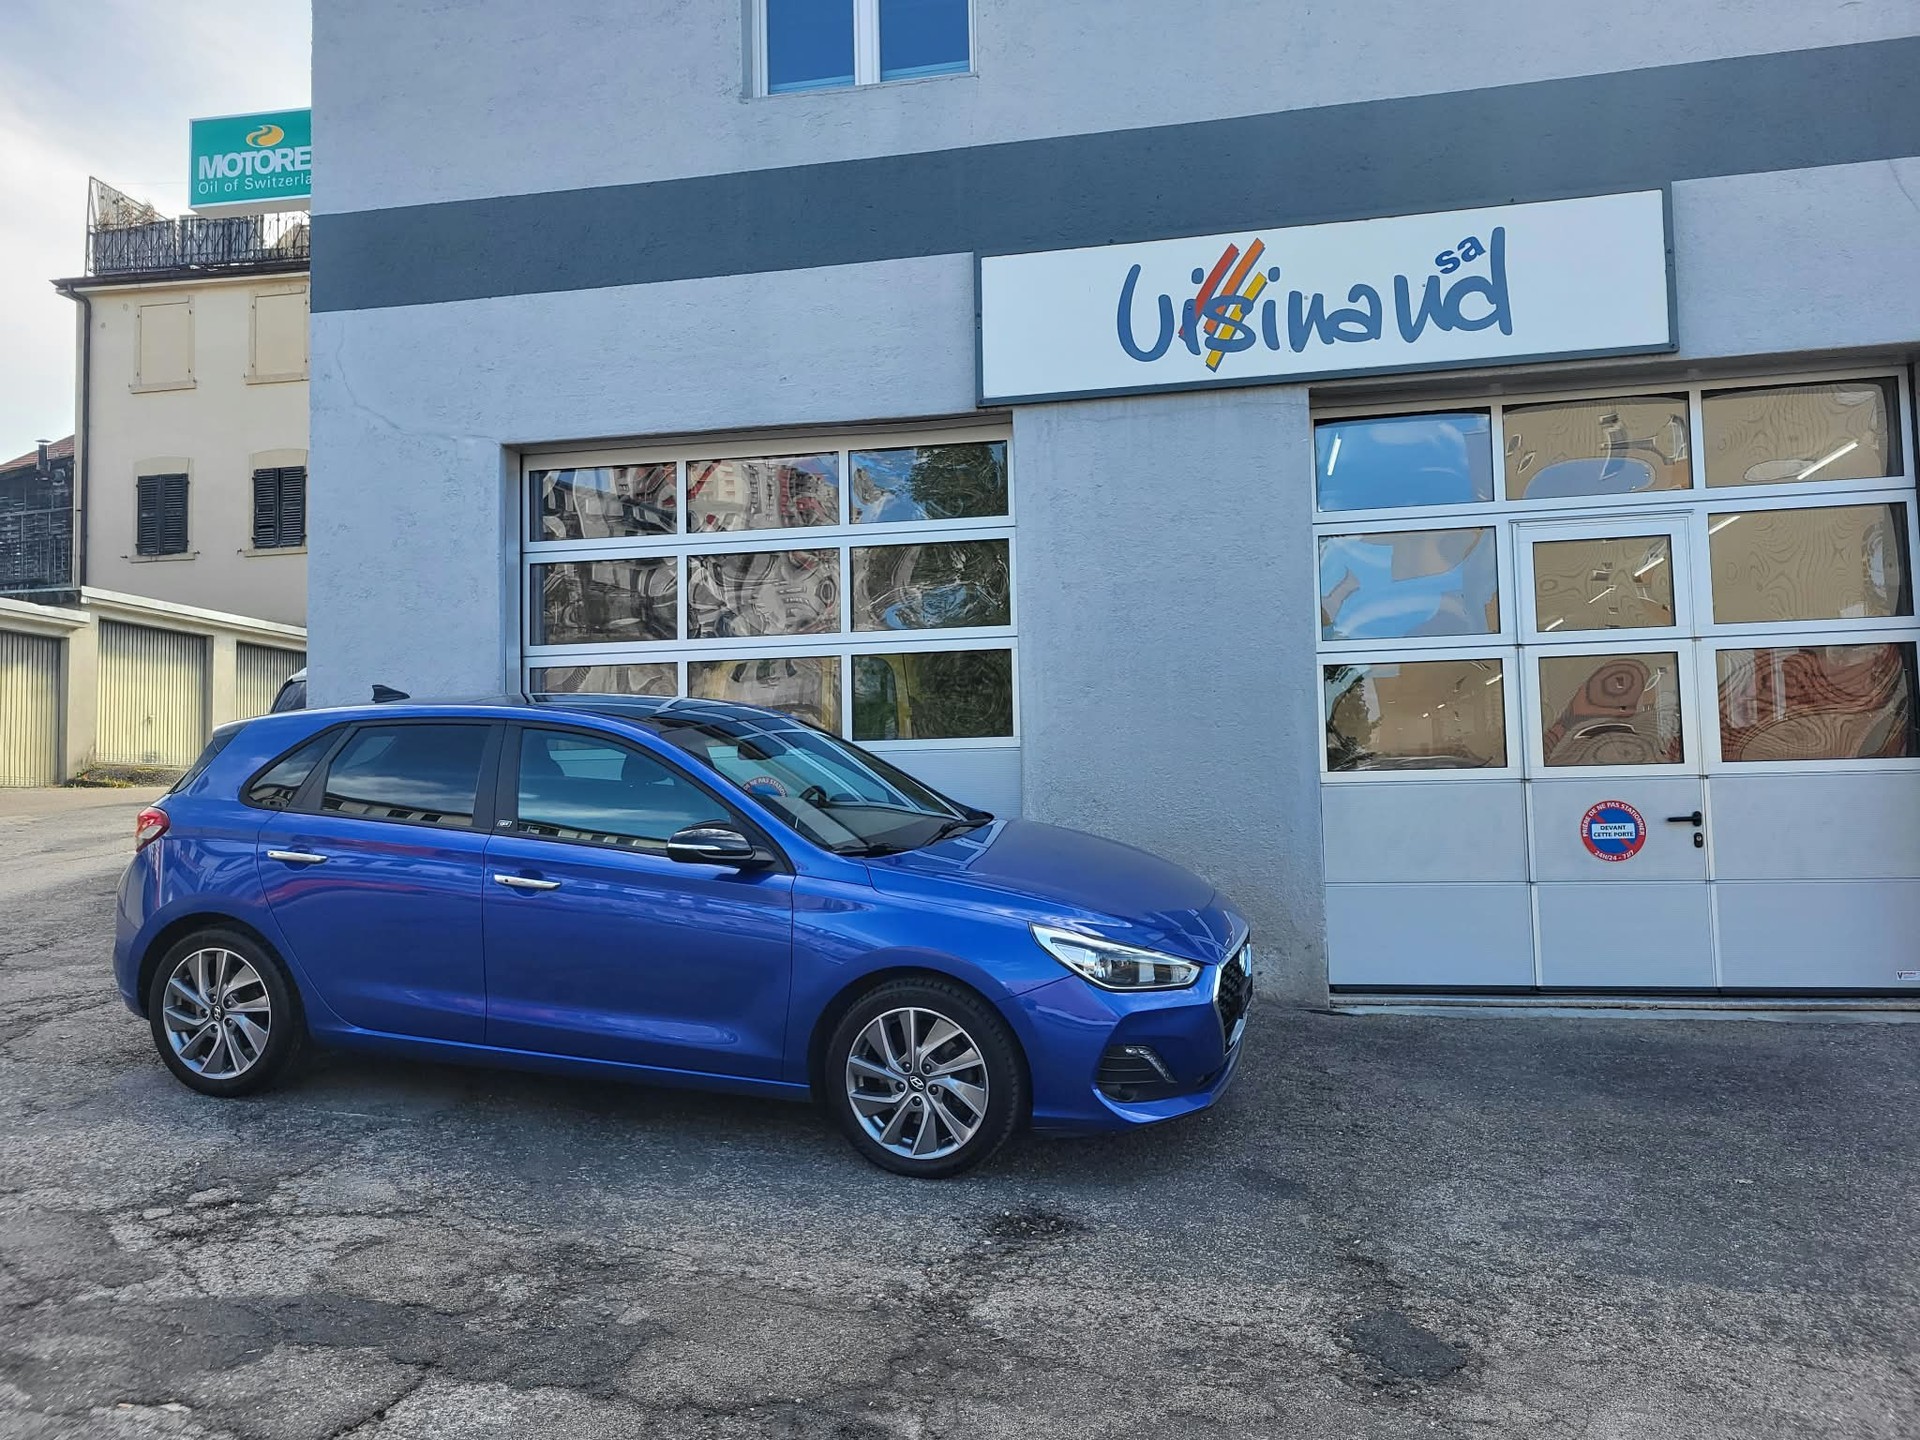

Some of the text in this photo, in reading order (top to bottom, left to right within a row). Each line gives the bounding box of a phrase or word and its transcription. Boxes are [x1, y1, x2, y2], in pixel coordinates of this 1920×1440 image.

[198, 146, 311, 180] MOTORE
[198, 172, 311, 194] Oil of Switzerla
[1589, 809, 1598, 817] DE
[1597, 803, 1606, 811] NE
[1621, 803, 1645, 836] STATIONNER
